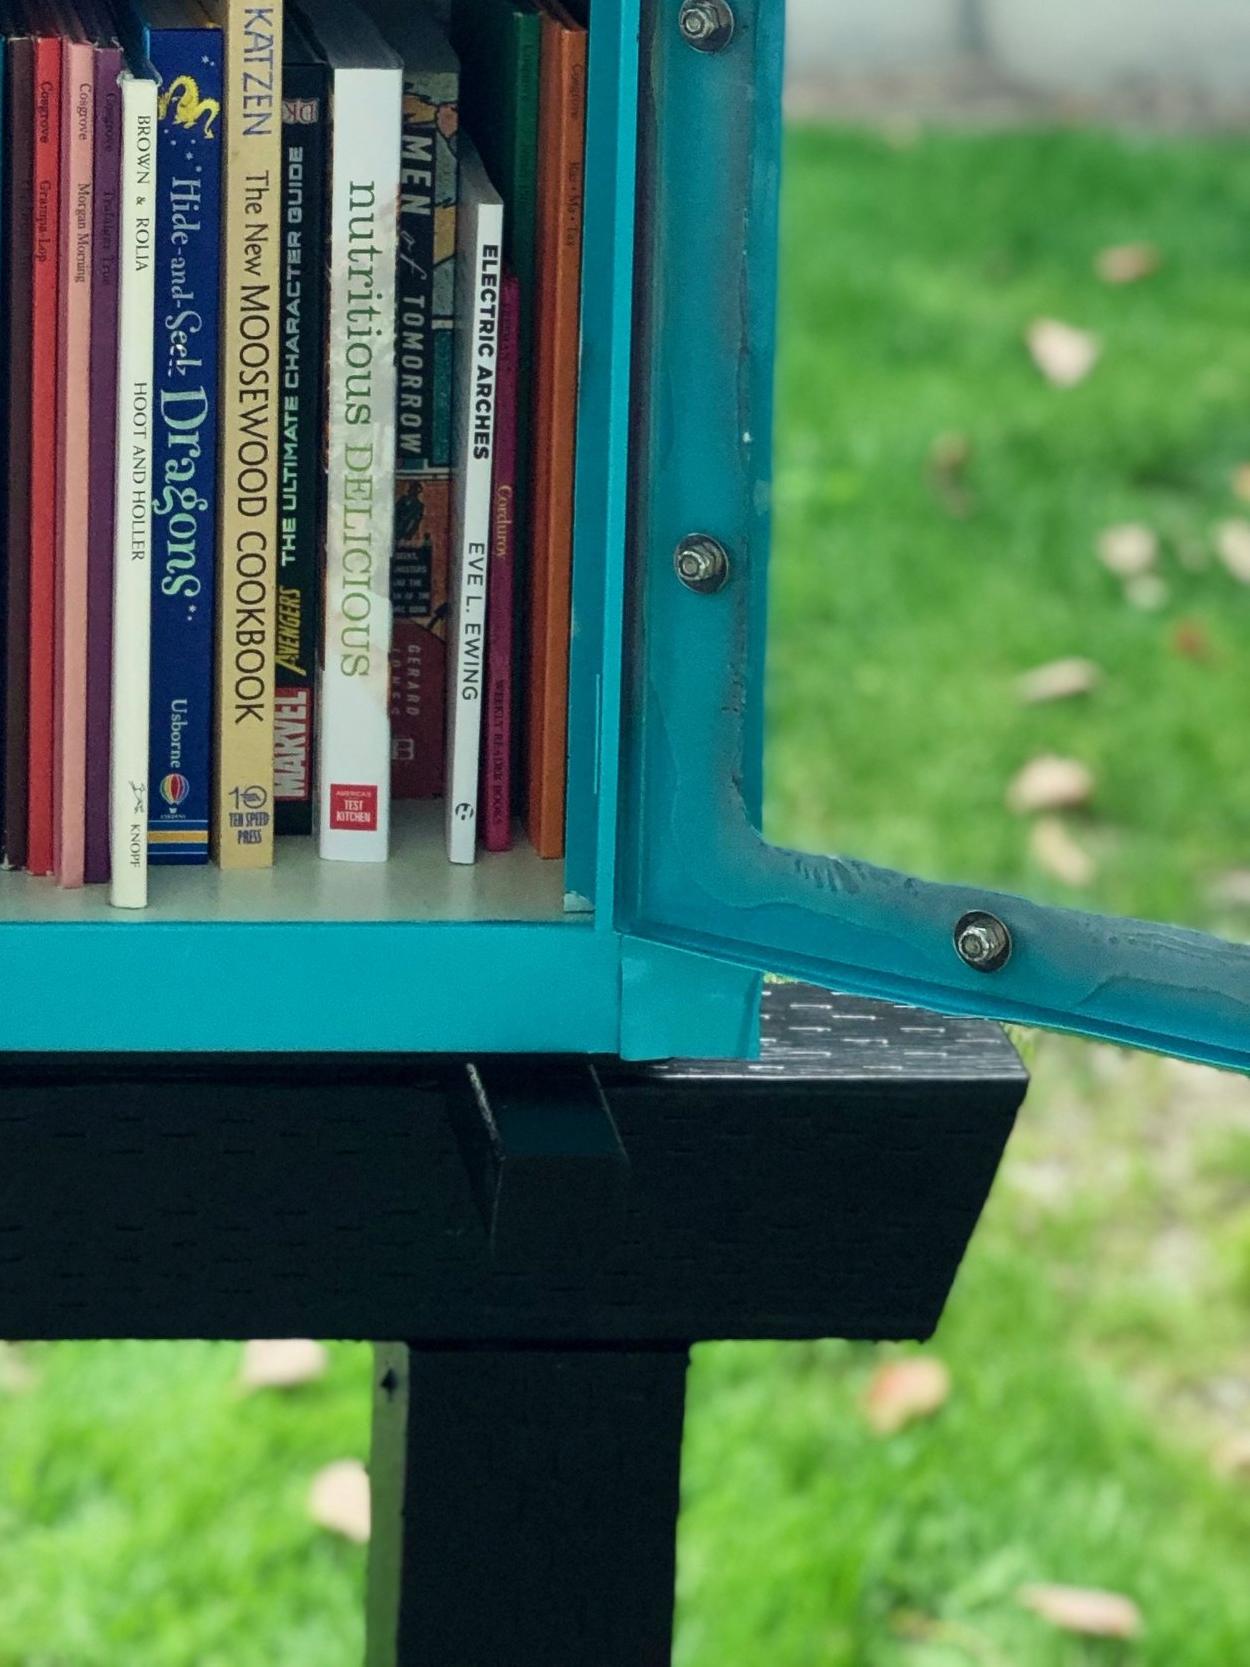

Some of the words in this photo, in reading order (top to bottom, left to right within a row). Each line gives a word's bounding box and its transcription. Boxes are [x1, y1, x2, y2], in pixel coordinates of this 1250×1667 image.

[242, 8, 274, 135] KATZEN
[77, 83, 91, 141] Cosgrove
[136, 115, 151, 184] BROWN
[401, 134, 432, 215] MEN
[75, 184, 90, 229] Morgan
[136, 196, 146, 206] &
[245, 170, 270, 214] The
[288, 147, 303, 223] GUIDE
[74, 233, 89, 283] Morning
[135, 218, 150, 272] ROLIA
[165, 177, 202, 377] Hide-and-Seek
[244, 224, 269, 275] New
[400, 230, 427, 280] of
[285, 232, 302, 388] CHARACTER
[346, 181, 383, 425] nutritious
[478, 245, 499, 357] ELECTRIC
[237, 285, 271, 517] MOOSEWOOD
[401, 294, 426, 453] TOMORROW
[133, 382, 147, 439] HOOT
[473, 365, 493, 459] ARCHES
[132, 446, 146, 485] AND
[282, 397, 299, 510] ULTIMATE
[131, 491, 146, 561] HOLLER
[151, 387, 209, 596] Dragons
[495, 484, 513, 559] Corduroy
[282, 518, 298, 566] THE
[341, 443, 373, 676] DELICIOUS
[467, 542, 485, 584] EVE
[235, 531, 267, 724] COOKBOOK
[275, 585, 307, 676] AVENGERS
[465, 594, 482, 613] L.
[407, 645, 422, 716] GERARD
[462, 623, 480, 701] EWING
[170, 699, 188, 768] Usborne
[274, 692, 307, 796] MARVEL
[337, 812, 370, 822] KITCHEN
[344, 800, 363, 811] TEST
[129, 825, 141, 868] KNOPF
